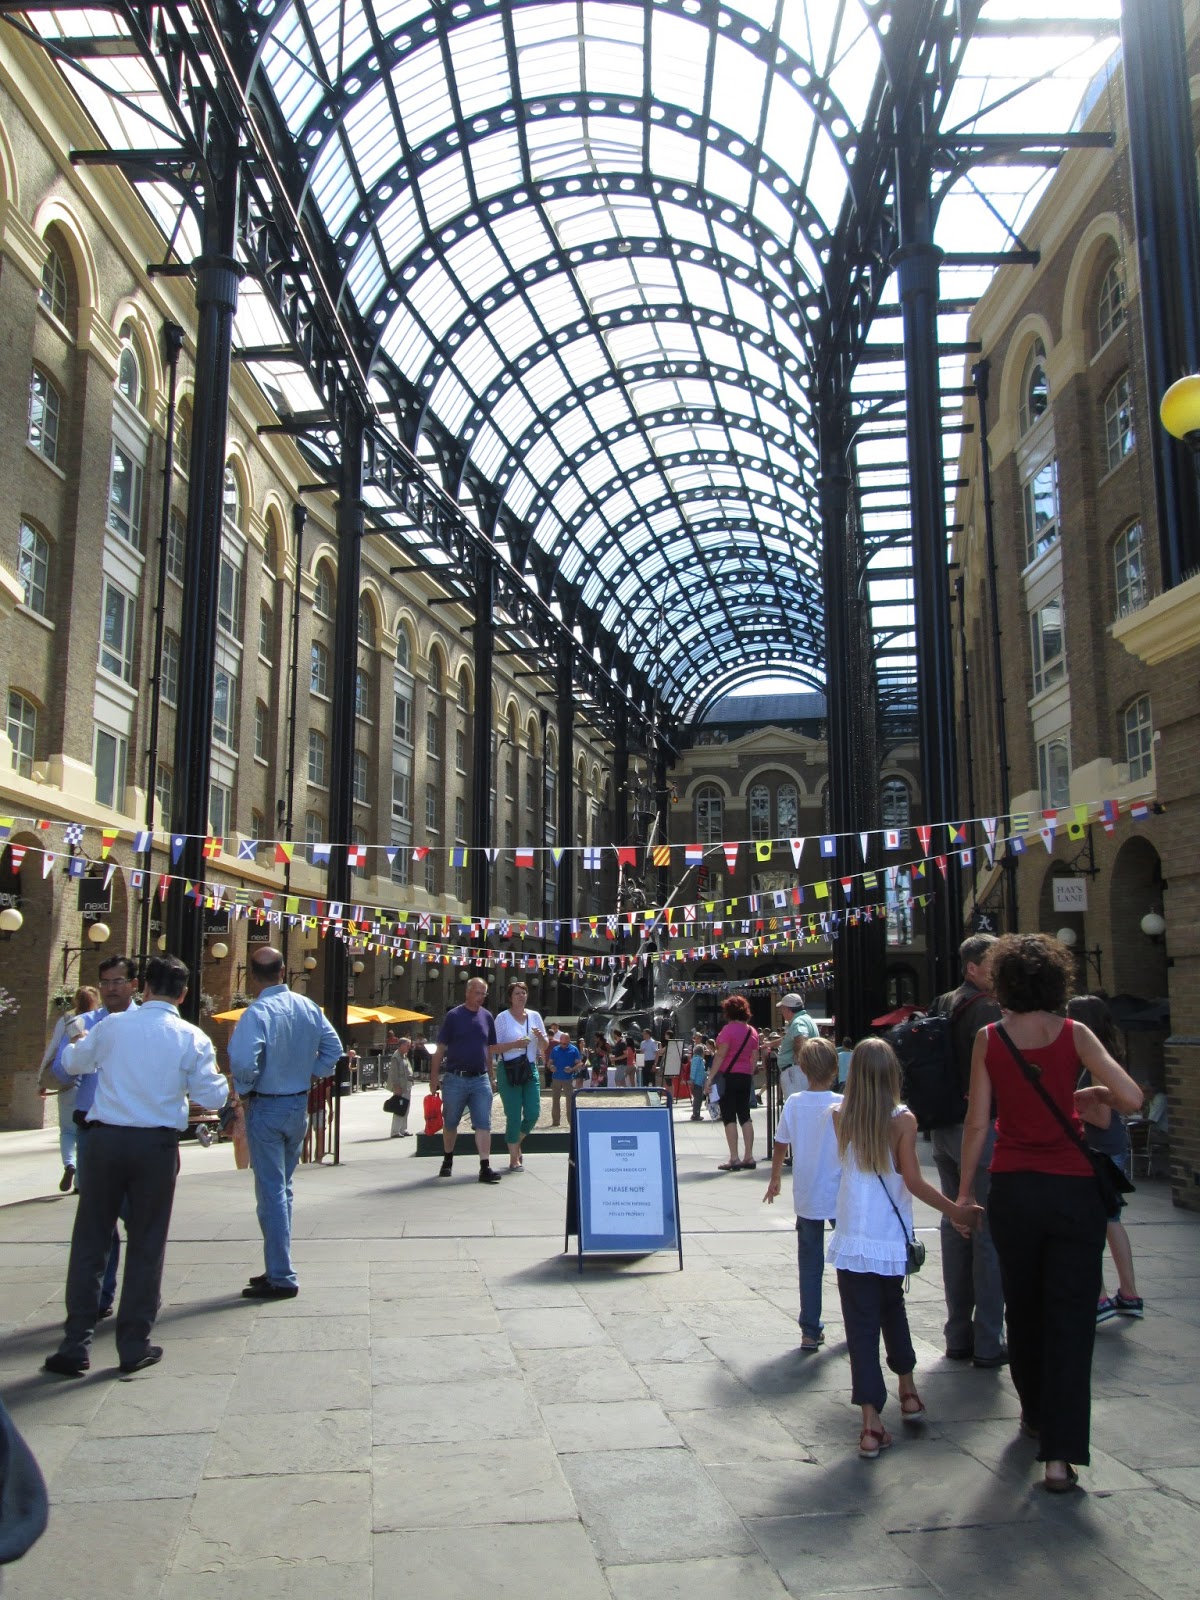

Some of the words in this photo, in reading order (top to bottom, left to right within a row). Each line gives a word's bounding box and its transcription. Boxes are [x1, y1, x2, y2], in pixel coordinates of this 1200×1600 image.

[1056, 886, 1083, 894] HAY'S
[1057, 895, 1083, 903] LANE
[84, 902, 108, 911] next
[207, 925, 228, 934] next
